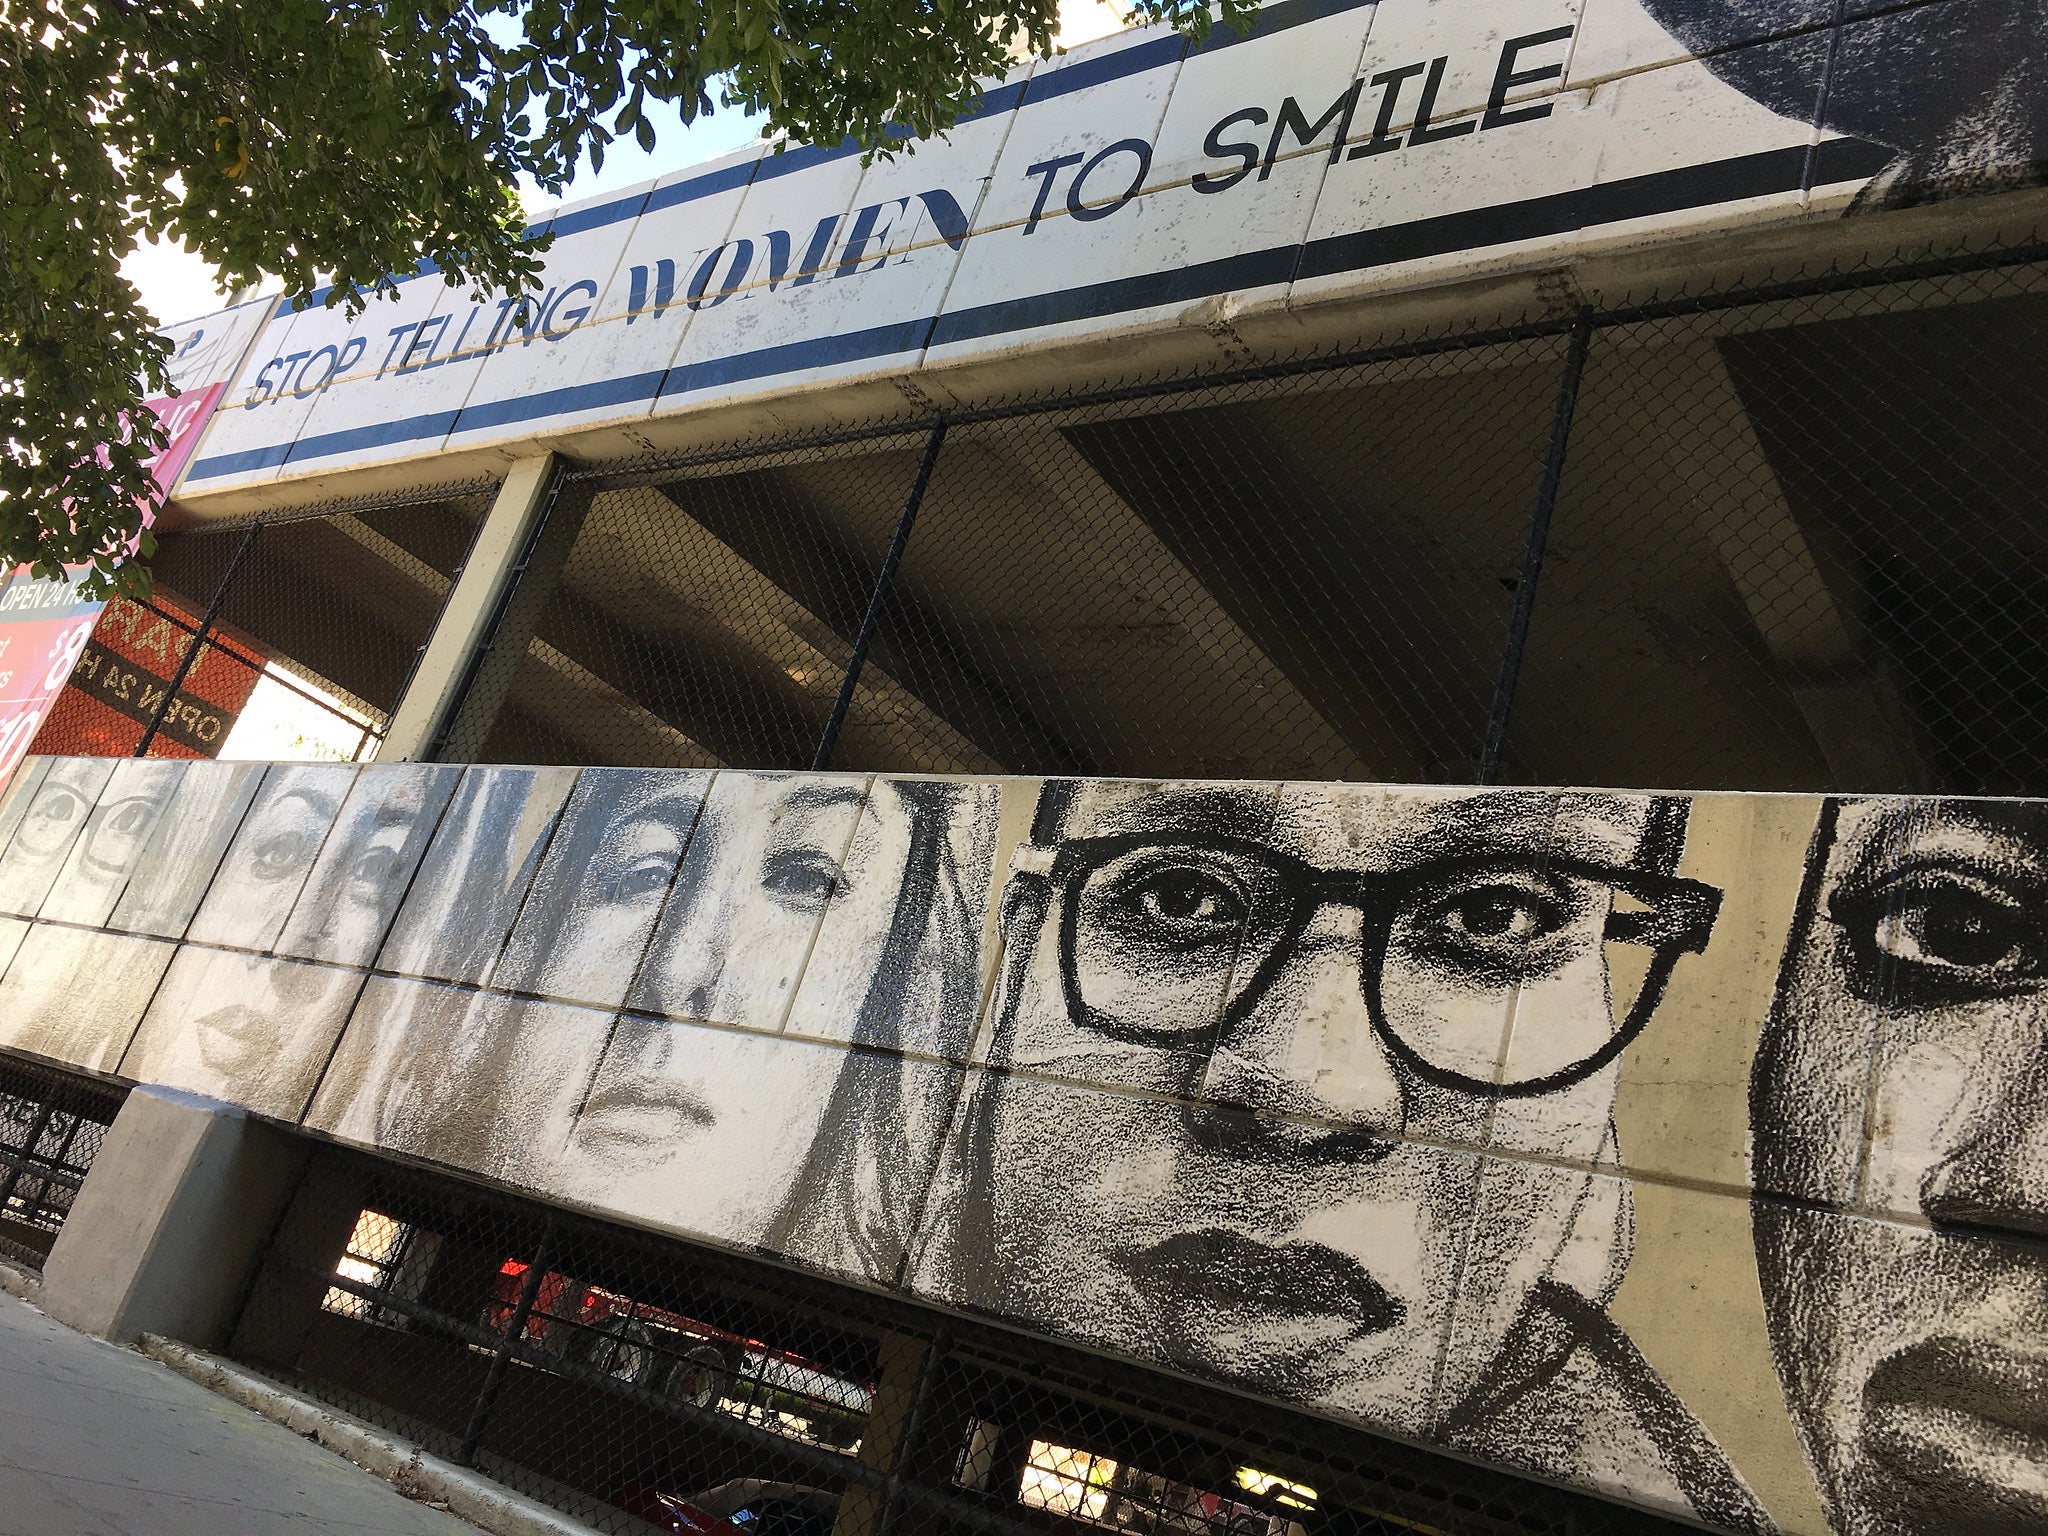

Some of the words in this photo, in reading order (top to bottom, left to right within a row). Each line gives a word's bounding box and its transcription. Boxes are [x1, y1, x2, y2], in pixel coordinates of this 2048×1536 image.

[244, 336, 367, 410] STOP
[374, 279, 598, 382] TELLING
[627, 177, 993, 326] WOMEN
[1023, 139, 1153, 236] TO
[1192, 25, 1575, 195] SMILE
[0, 583, 49, 612] OPEN
[42, 582, 66, 608] 24
